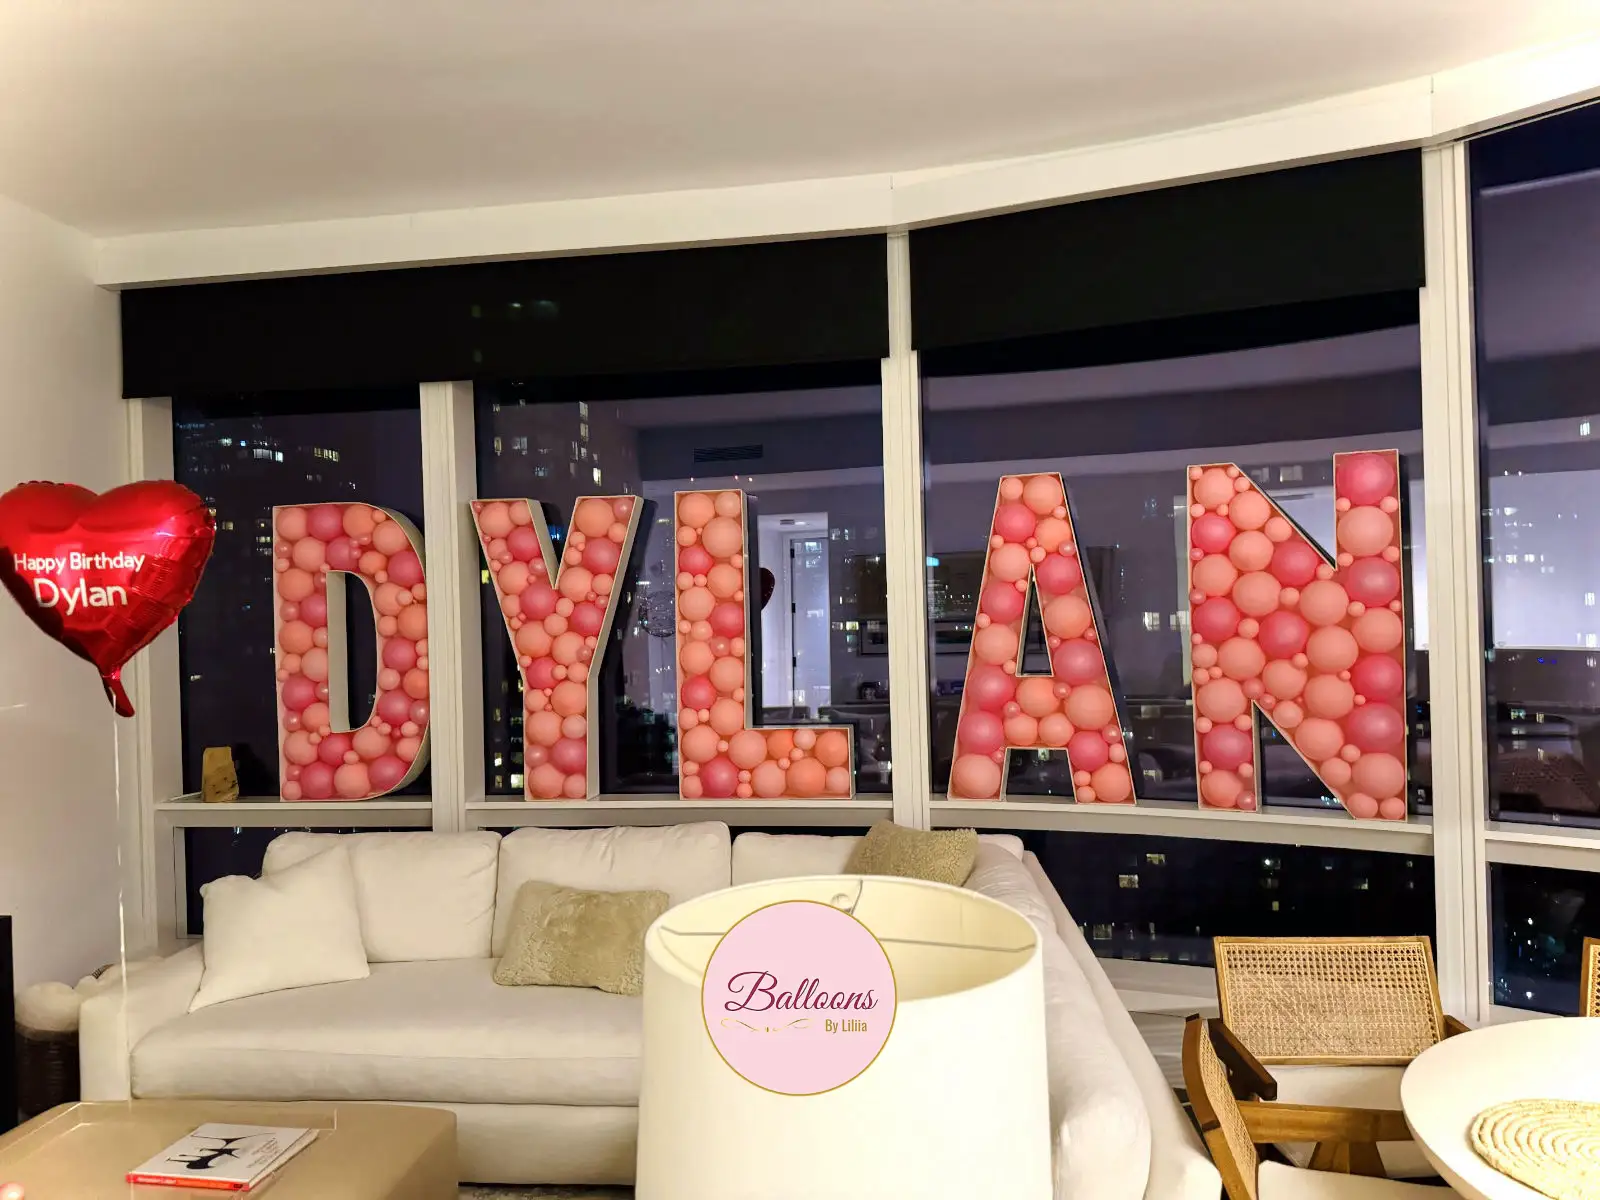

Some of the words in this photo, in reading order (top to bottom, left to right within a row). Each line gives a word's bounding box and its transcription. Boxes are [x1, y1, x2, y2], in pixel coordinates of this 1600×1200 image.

[13, 552, 67, 575] Happy
[69, 551, 145, 572] Birthday
[33, 577, 128, 616] Dylan
[272, 448, 1408, 820] DYLAN
